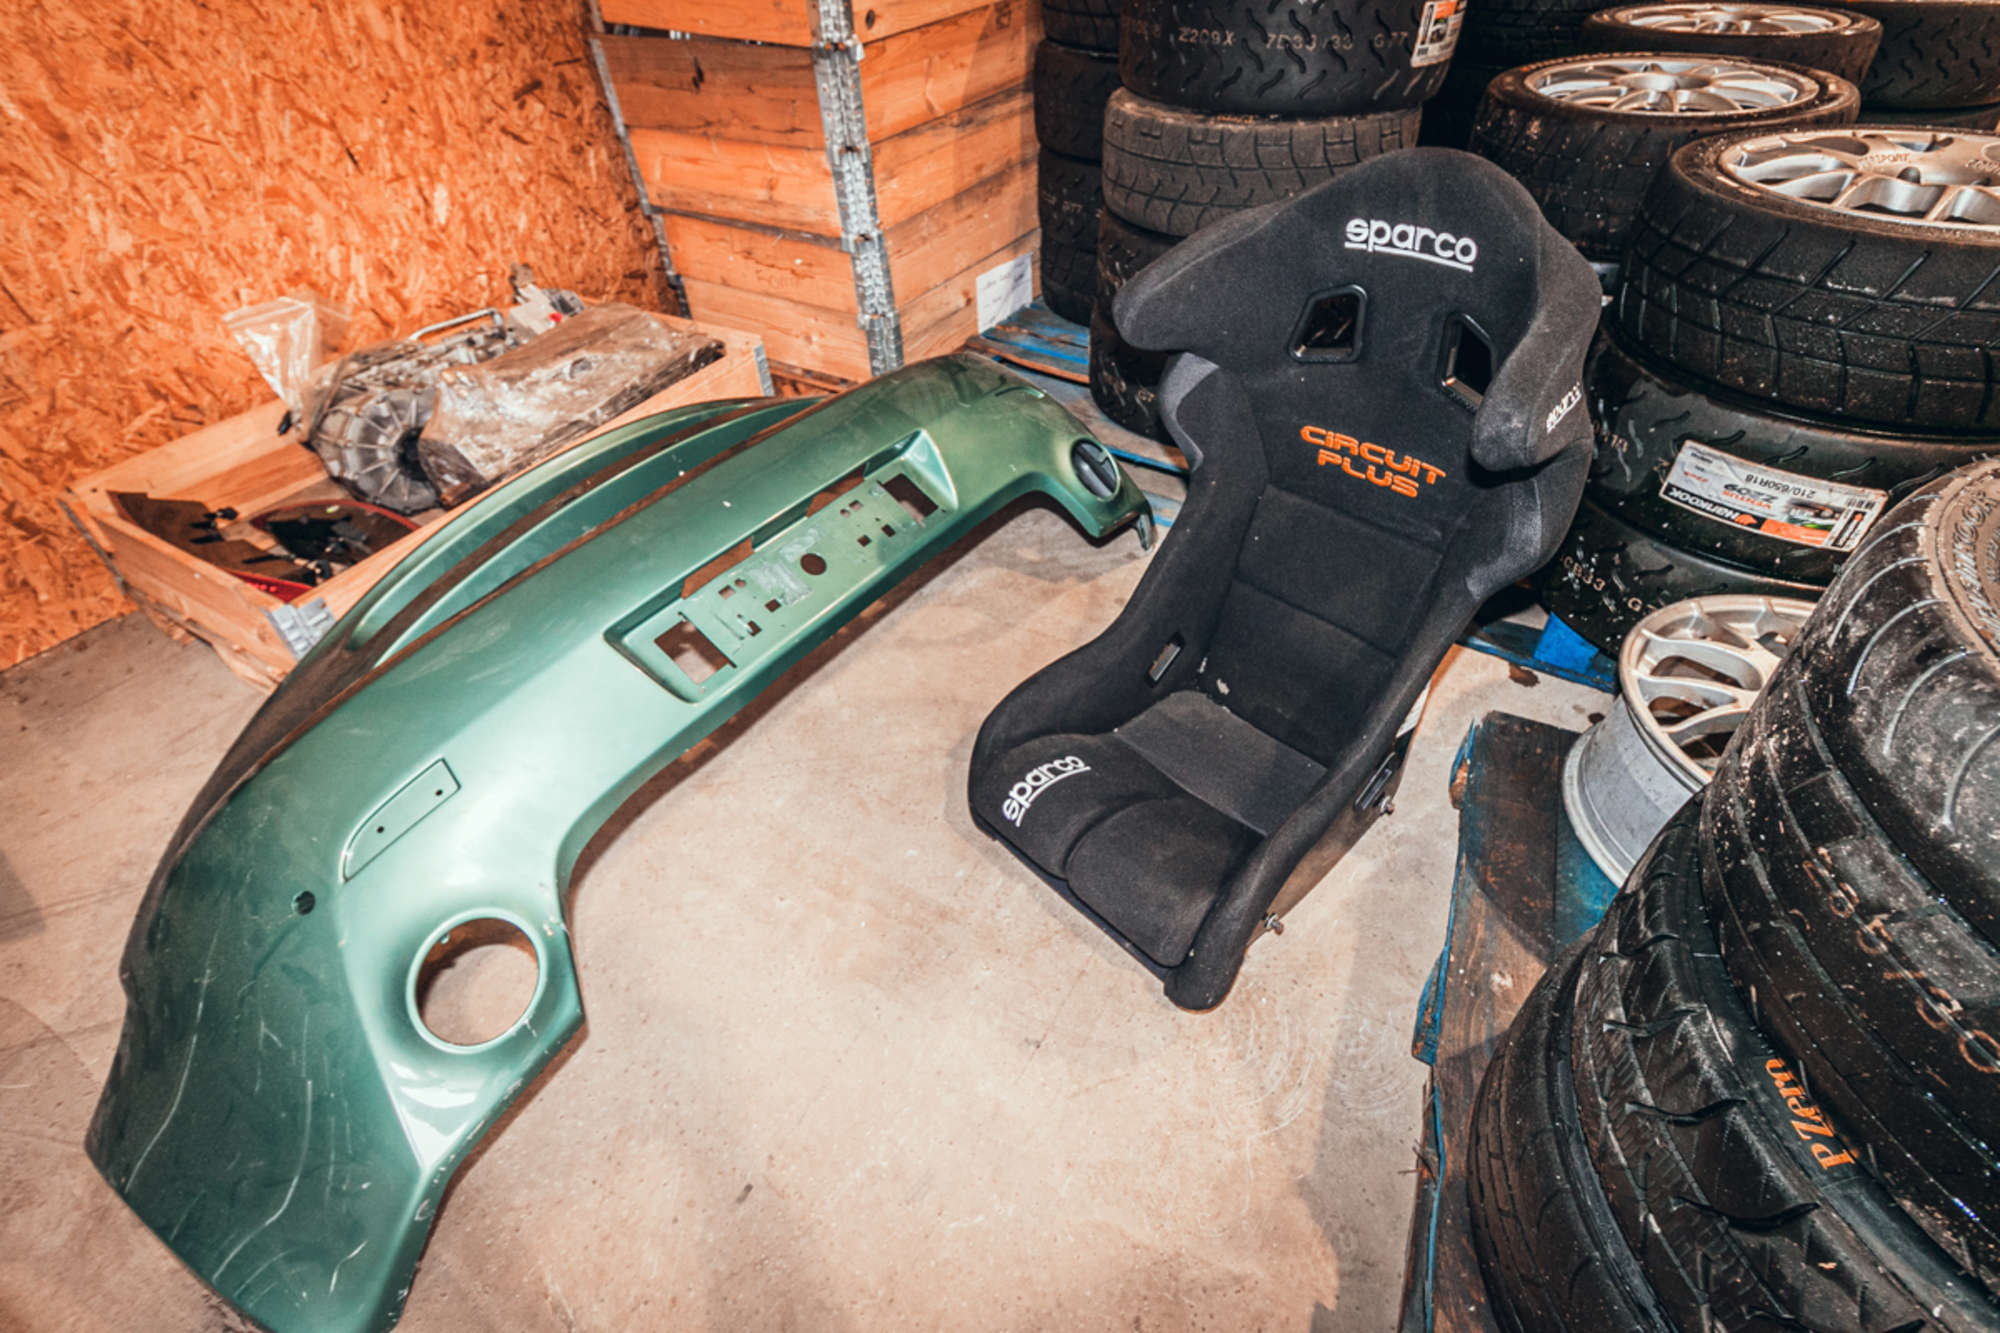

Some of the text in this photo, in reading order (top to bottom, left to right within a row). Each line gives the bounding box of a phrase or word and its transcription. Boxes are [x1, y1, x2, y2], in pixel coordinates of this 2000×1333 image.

[1344, 217, 1479, 266] sparco
[1300, 425, 1447, 485] CIRCUIT
[1317, 448, 1419, 498] PLUS
[1745, 474, 1816, 499] 210/650R18
[1002, 755, 1085, 822] sparco
